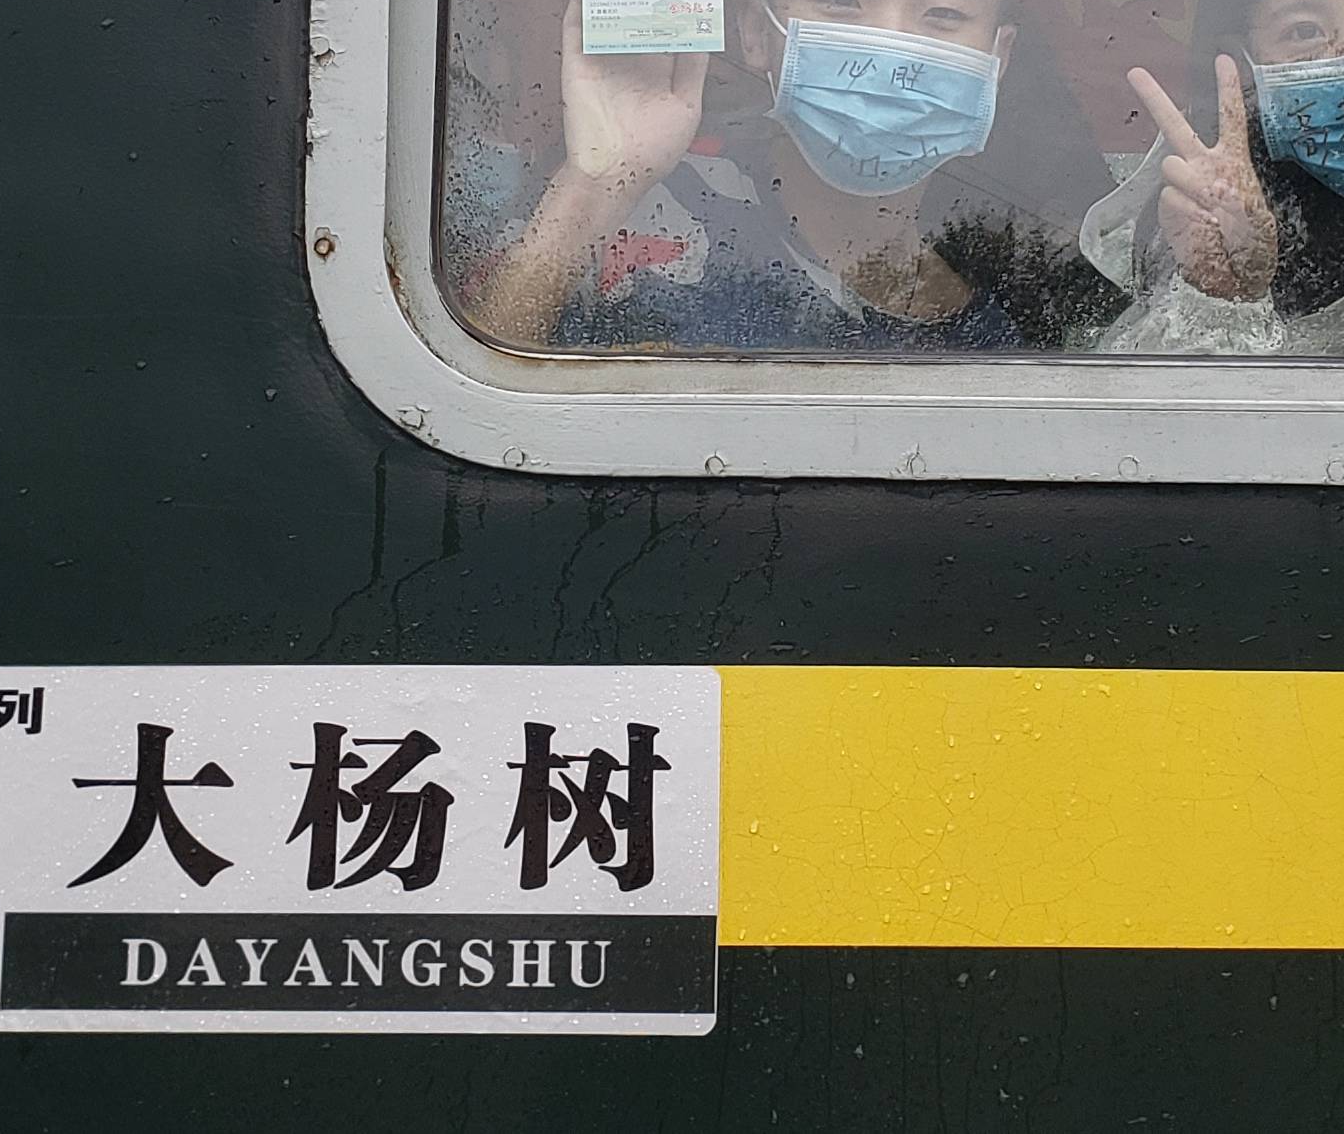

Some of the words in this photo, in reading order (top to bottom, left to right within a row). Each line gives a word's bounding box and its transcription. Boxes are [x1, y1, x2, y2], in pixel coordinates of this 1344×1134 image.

[66, 721, 673, 892] 大杨树
[119, 937, 613, 988] DAYANGSHU
